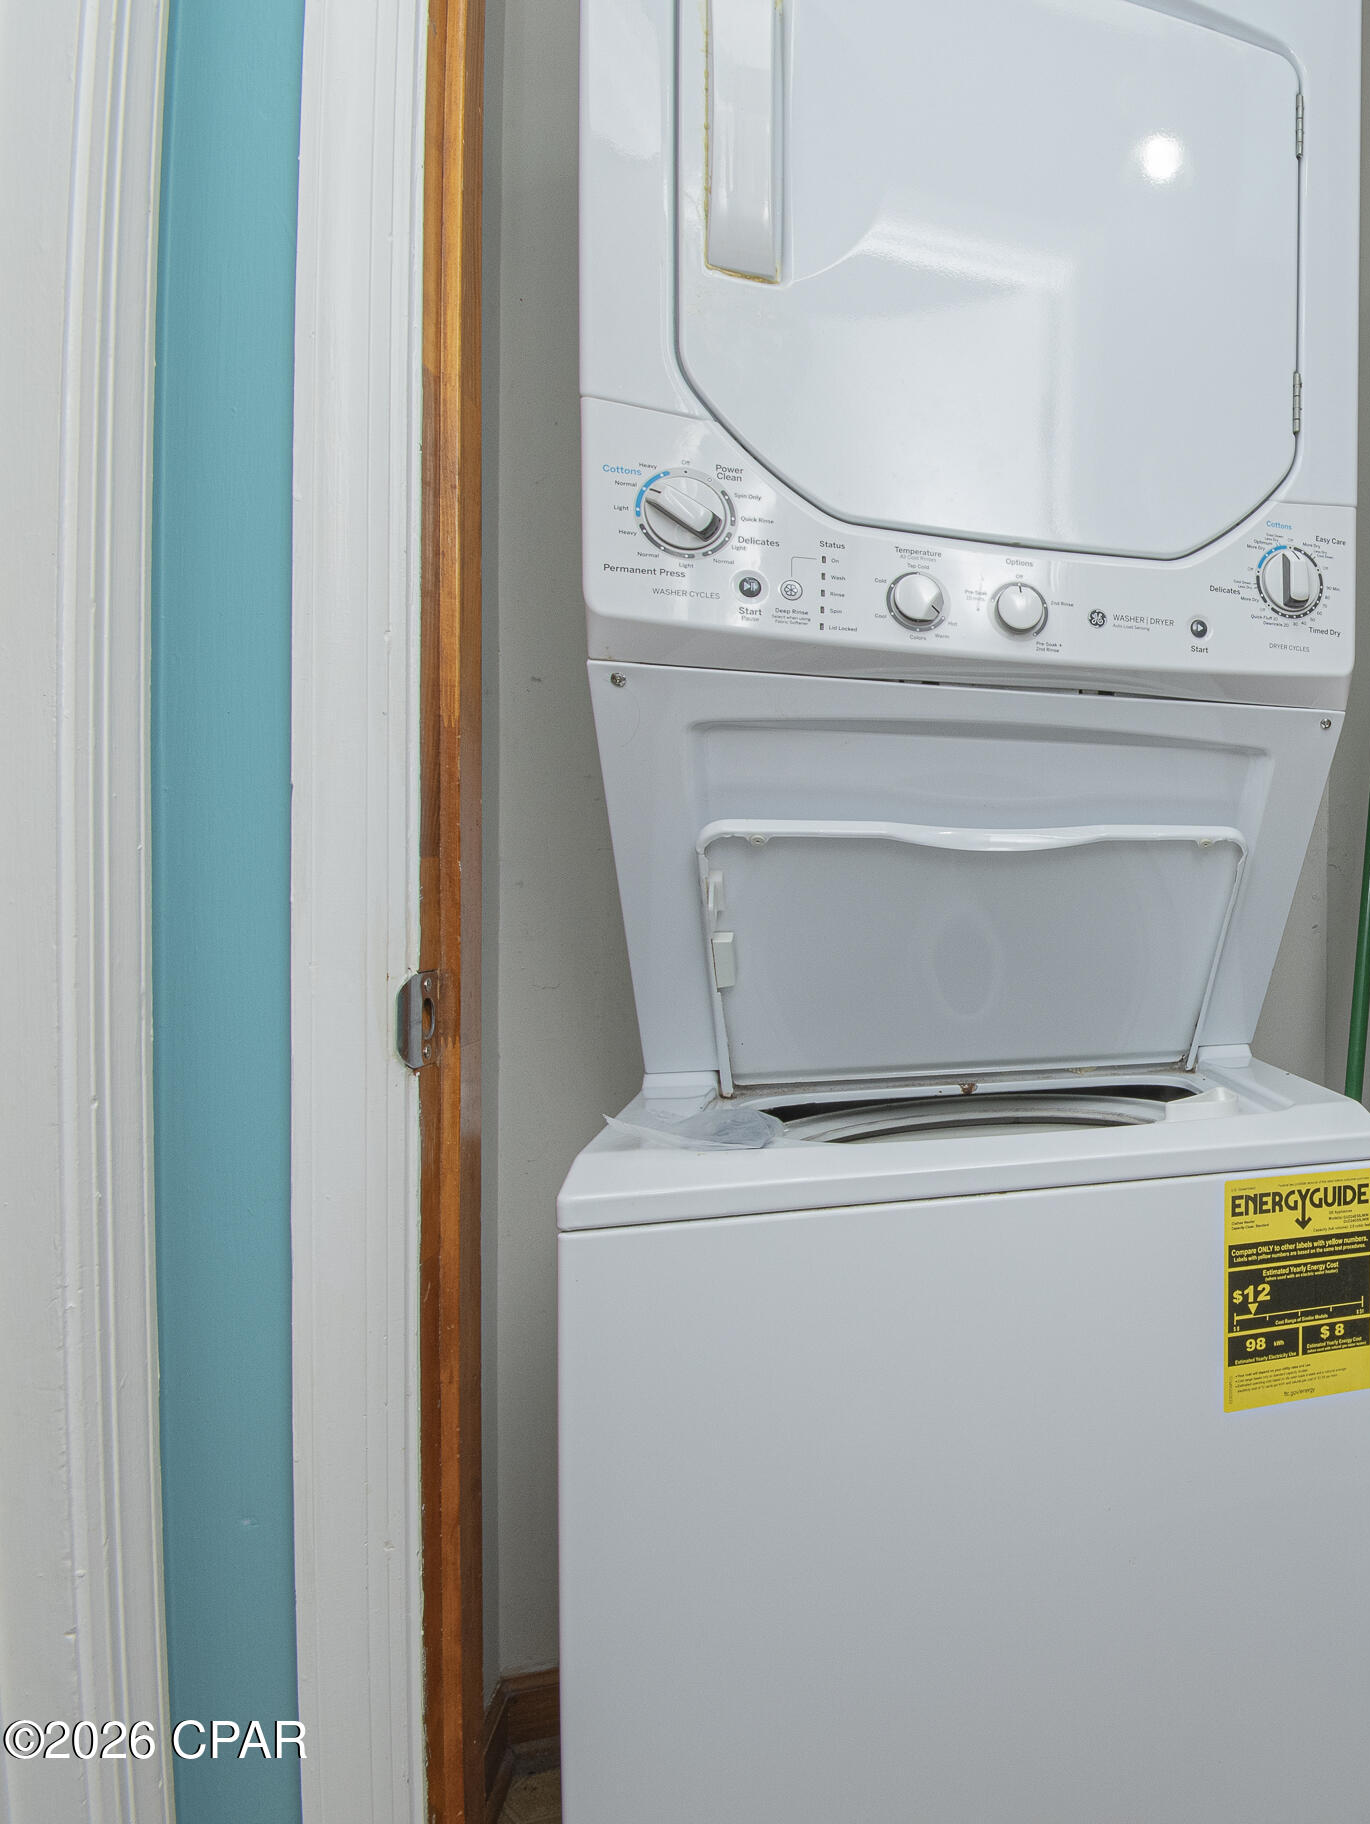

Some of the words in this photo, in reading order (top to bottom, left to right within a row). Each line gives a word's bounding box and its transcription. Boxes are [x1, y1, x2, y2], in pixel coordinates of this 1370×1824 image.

[603, 464, 642, 475] Cottons
[716, 465, 744, 474] Power
[717, 473, 742, 482] Clean
[1266, 520, 1292, 530] Cottons
[738, 536, 779, 547] Delicates
[820, 541, 845, 549] Status
[1316, 536, 1330, 544] Easy
[1332, 538, 1346, 546] Care
[895, 546, 942, 557] Temperature
[1006, 558, 1033, 567] Options
[604, 564, 656, 575] Permanent
[660, 569, 685, 578] Press
[653, 588, 687, 597] WASHER
[689, 591, 720, 599] CYCLES
[1210, 585, 1241, 595] Delicates
[739, 607, 762, 616] Start
[1113, 614, 1145, 623] WASHER
[1150, 618, 1174, 626] DRYER
[1309, 627, 1328, 635] Timed
[1330, 629, 1341, 637] Dry
[1231, 1183, 1369, 1217] ENERGYGUIDE
[1231, 1248, 1256, 1256] Compare
[1258, 1245, 1273, 1253] ONLY
[1297, 1240, 1312, 1249] labels
[1314, 1239, 1324, 1247] with
[1326, 1238, 1343, 1247] yellow
[1344, 1236, 1368, 1244] numbers.
[1258, 1252, 1271, 1260] yellow
[1263, 1268, 1289, 1276] Estimated
[1290, 1266, 1306, 1274] Yearly
[1233, 1283, 1271, 1304] $12
[1335, 1324, 1344, 1336] 8
[1246, 1338, 1266, 1352] 98
